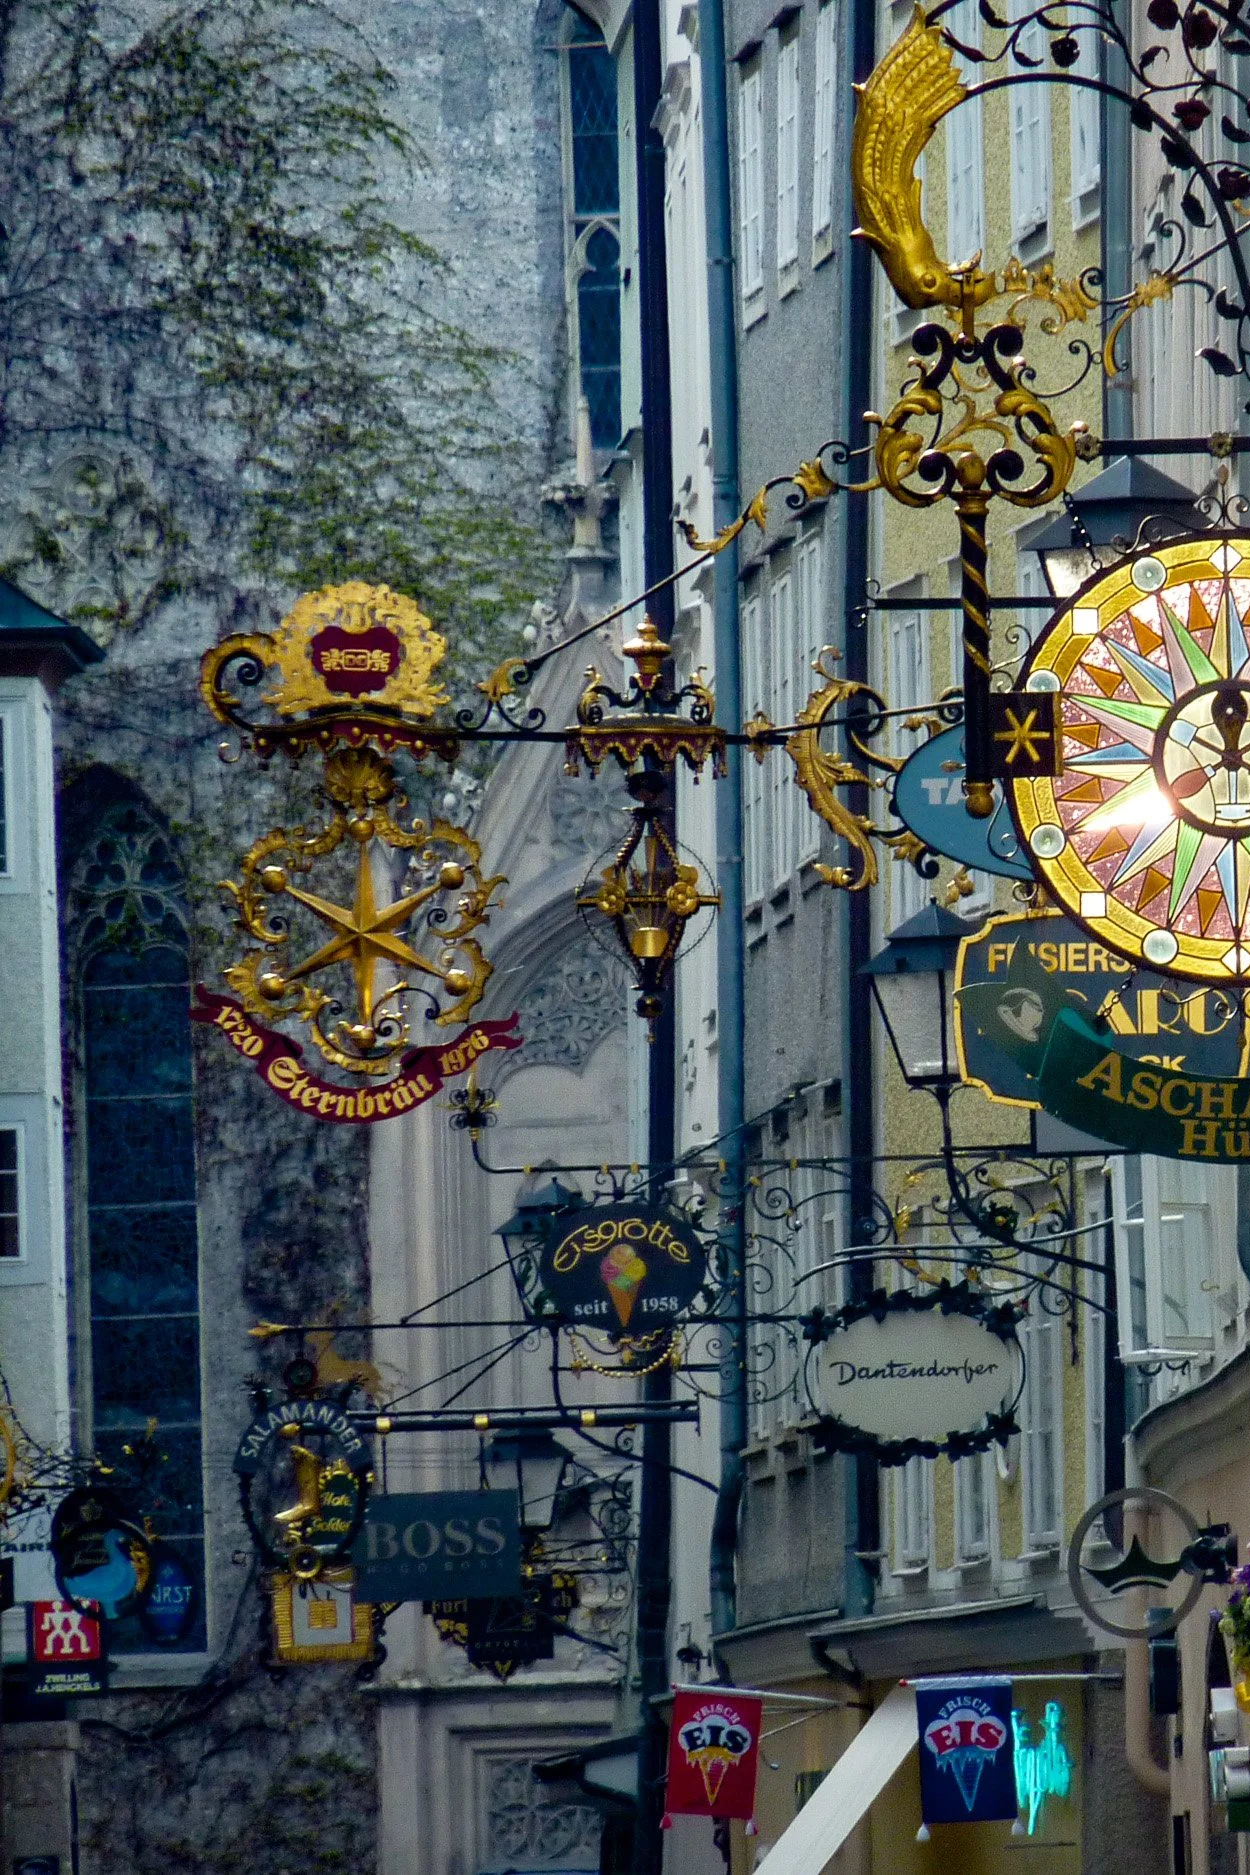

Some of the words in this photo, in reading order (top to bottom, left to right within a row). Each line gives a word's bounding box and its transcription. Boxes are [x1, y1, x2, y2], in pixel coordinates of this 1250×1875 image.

[214, 1004, 266, 1057] 1720
[439, 1030, 489, 1077] 1976
[267, 1056, 433, 1119] Sternbräu
[553, 1218, 691, 1272] Eisgrotte
[574, 1299, 608, 1316] seit
[641, 1296, 679, 1313] 1958
[829, 1358, 999, 1386] Dantendorfer
[241, 1403, 362, 1458] SALAMANDER
[366, 1517, 506, 1560] BOSS
[693, 1703, 741, 1725] FRISCH
[939, 1696, 991, 1720] FRISCH
[681, 1726, 748, 1754] EIS
[928, 1720, 1003, 1755] EIS
